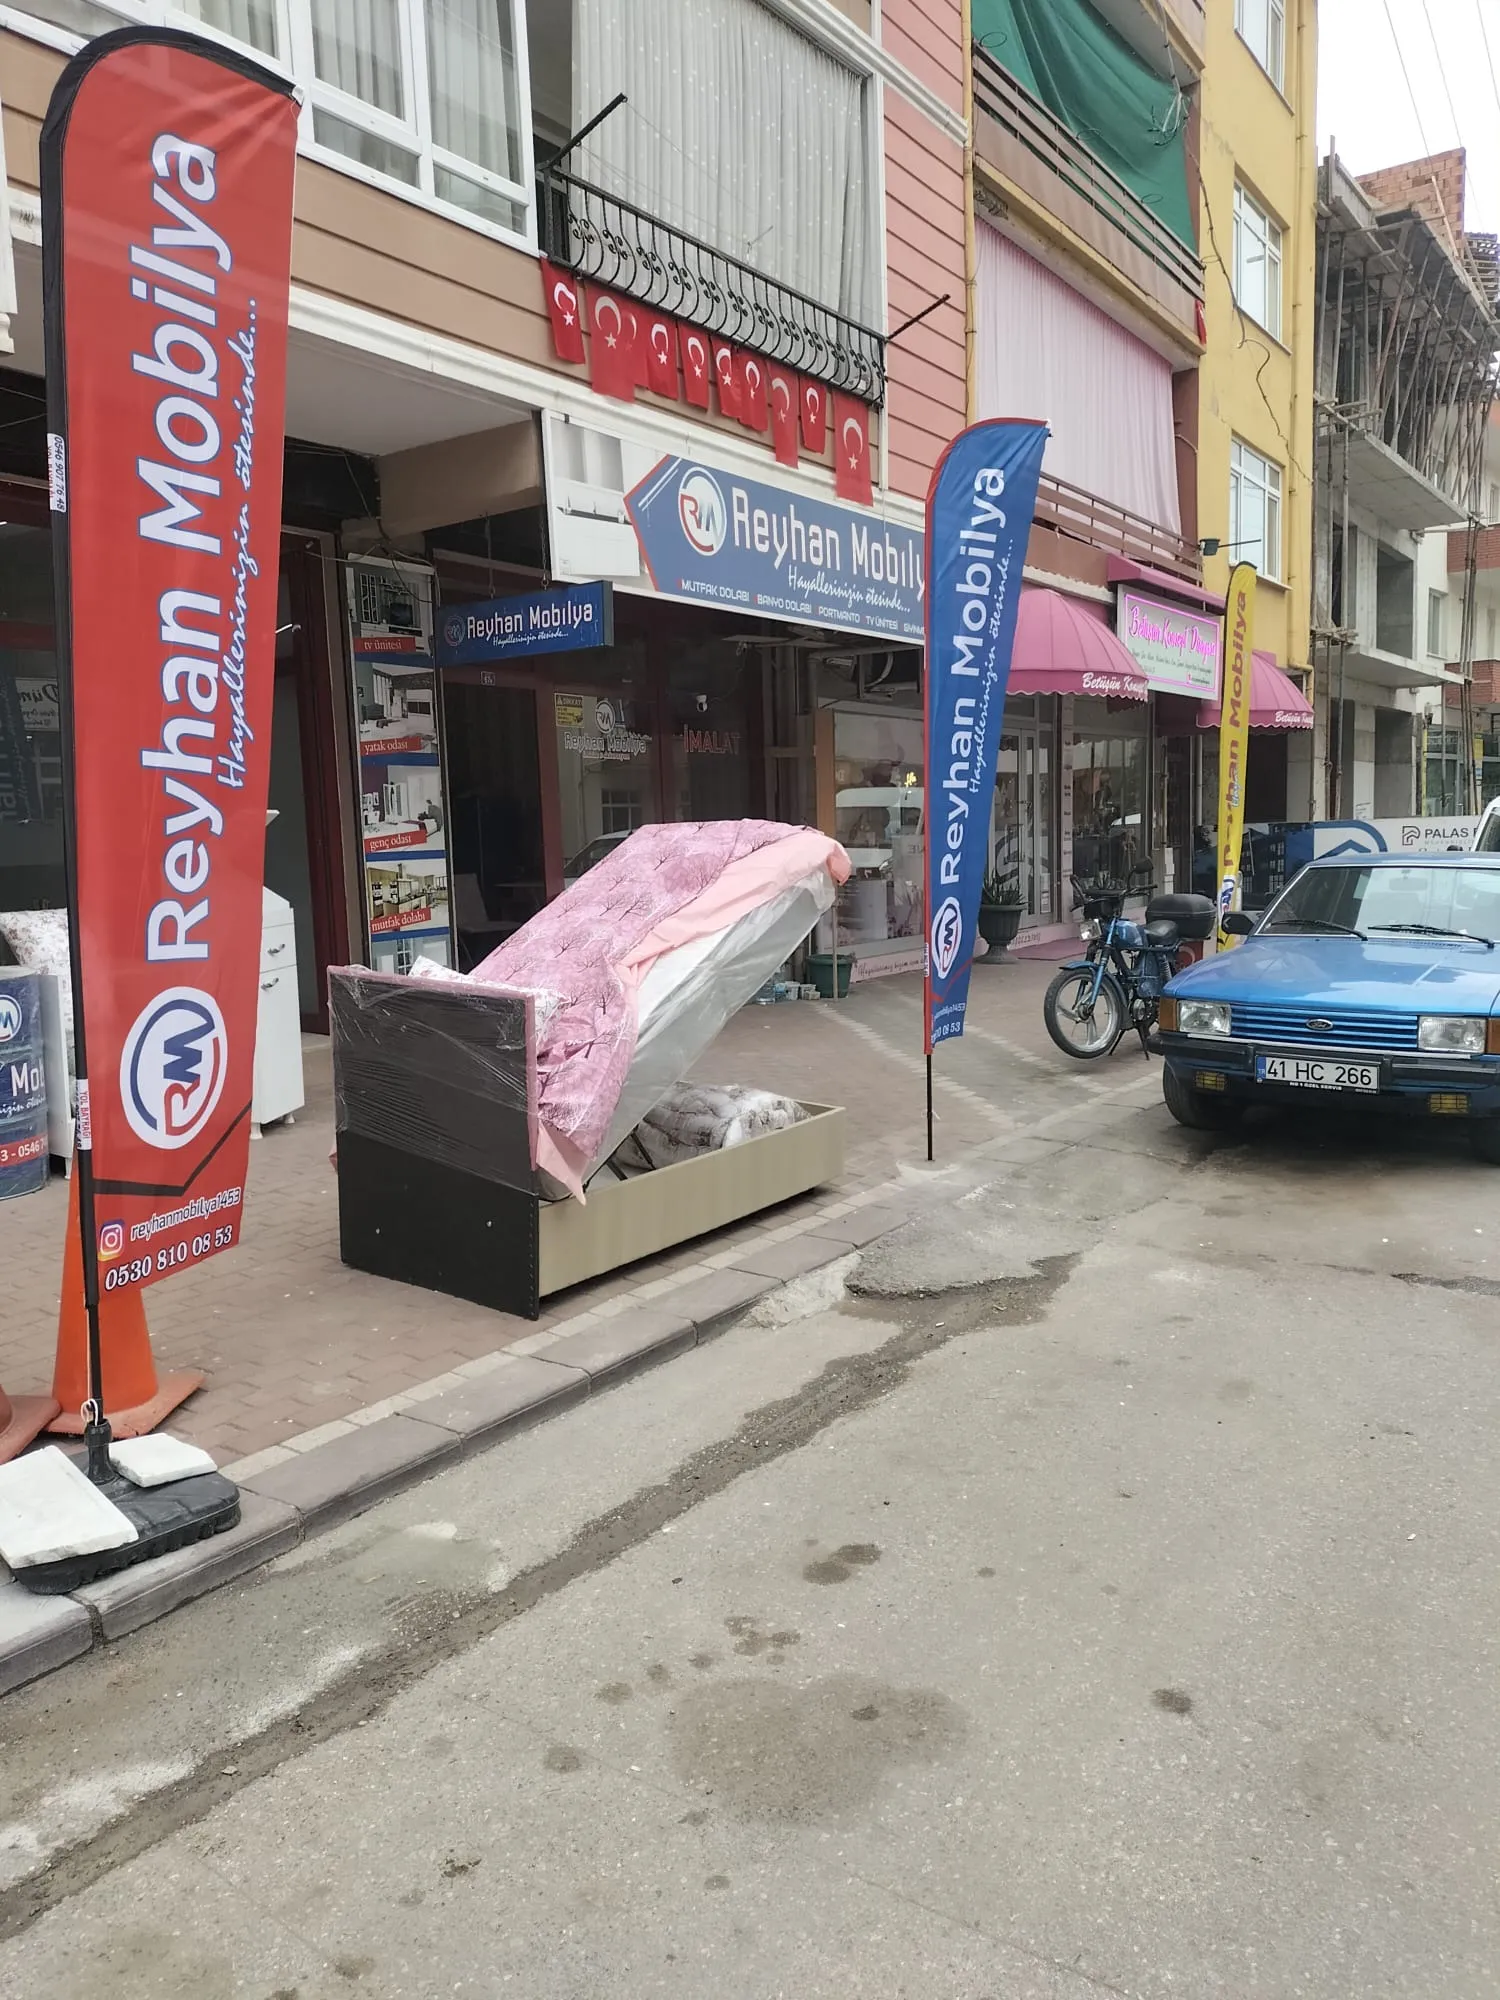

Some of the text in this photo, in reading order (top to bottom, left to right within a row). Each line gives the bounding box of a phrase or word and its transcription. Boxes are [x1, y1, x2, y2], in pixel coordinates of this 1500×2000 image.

[129, 131, 232, 962] Reyhan Mobilya
[732, 487, 841, 571] Reyhan
[681, 579, 719, 597] MUTFAK
[719, 586, 750, 602] DOLABI
[757, 594, 784, 609] BANYO
[785, 600, 812, 614] DOLABI
[818, 605, 861, 623] PORTMANTO
[865, 615, 875, 625] TV
[217, 503, 258, 789] Hayallerinizin
[364, 638, 402, 650] tv ünitesi
[467, 612, 523, 642] Reyhan
[940, 467, 1006, 885] Reyhan Mobilya
[1229, 591, 1247, 728] Mobilya
[364, 743, 386, 756] yatak
[564, 731, 604, 753] Reyhan
[369, 838, 389, 851] genç
[1424, 828, 1469, 839] PALAS
[371, 916, 400, 932] mutfak
[1267, 1060, 1372, 1086] 41 HC 266
[130, 1187, 242, 1242] reyhanmobilya1453
[105, 1224, 233, 1291] 0530 810 08 53
